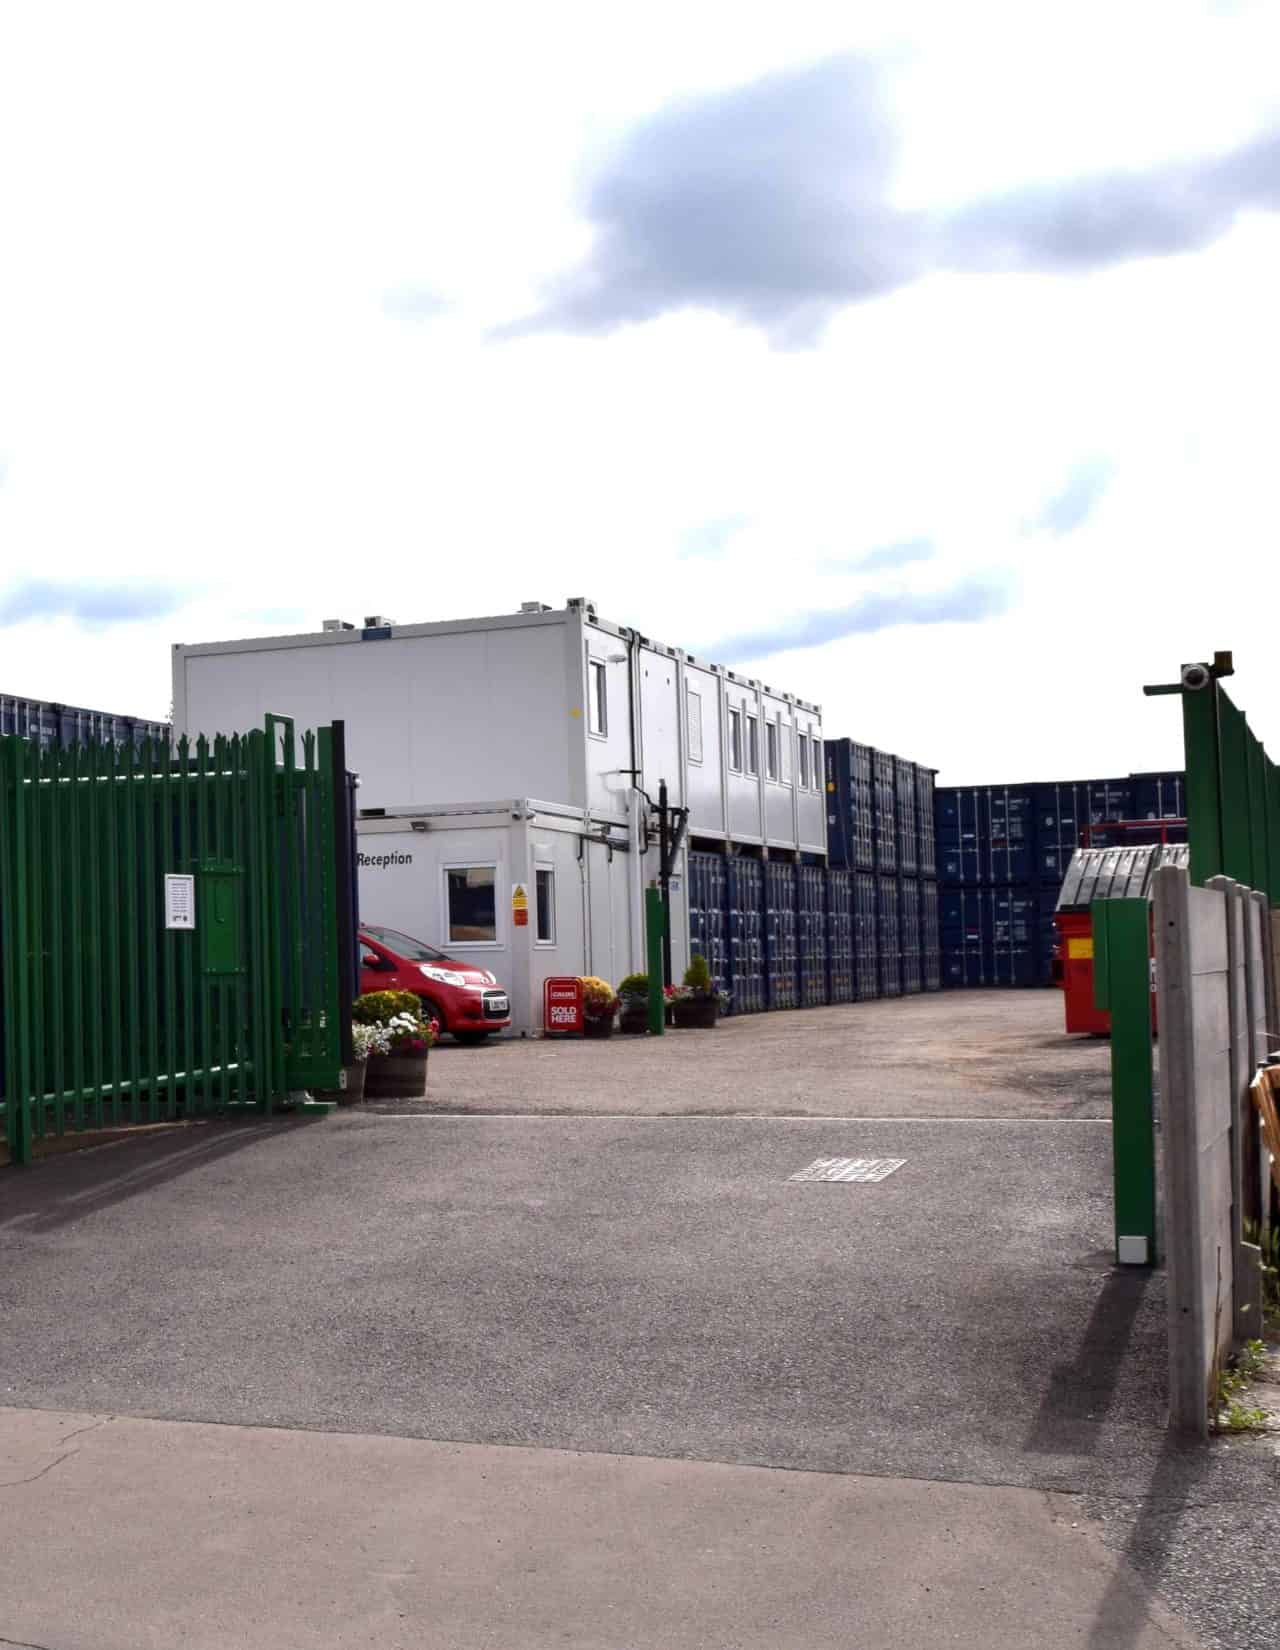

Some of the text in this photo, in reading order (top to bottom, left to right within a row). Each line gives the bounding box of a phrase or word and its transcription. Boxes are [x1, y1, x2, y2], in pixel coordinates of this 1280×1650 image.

[356, 850, 413, 870] Reception
[551, 1006, 577, 1015] SOLD
[551, 1014, 577, 1024] HERE
